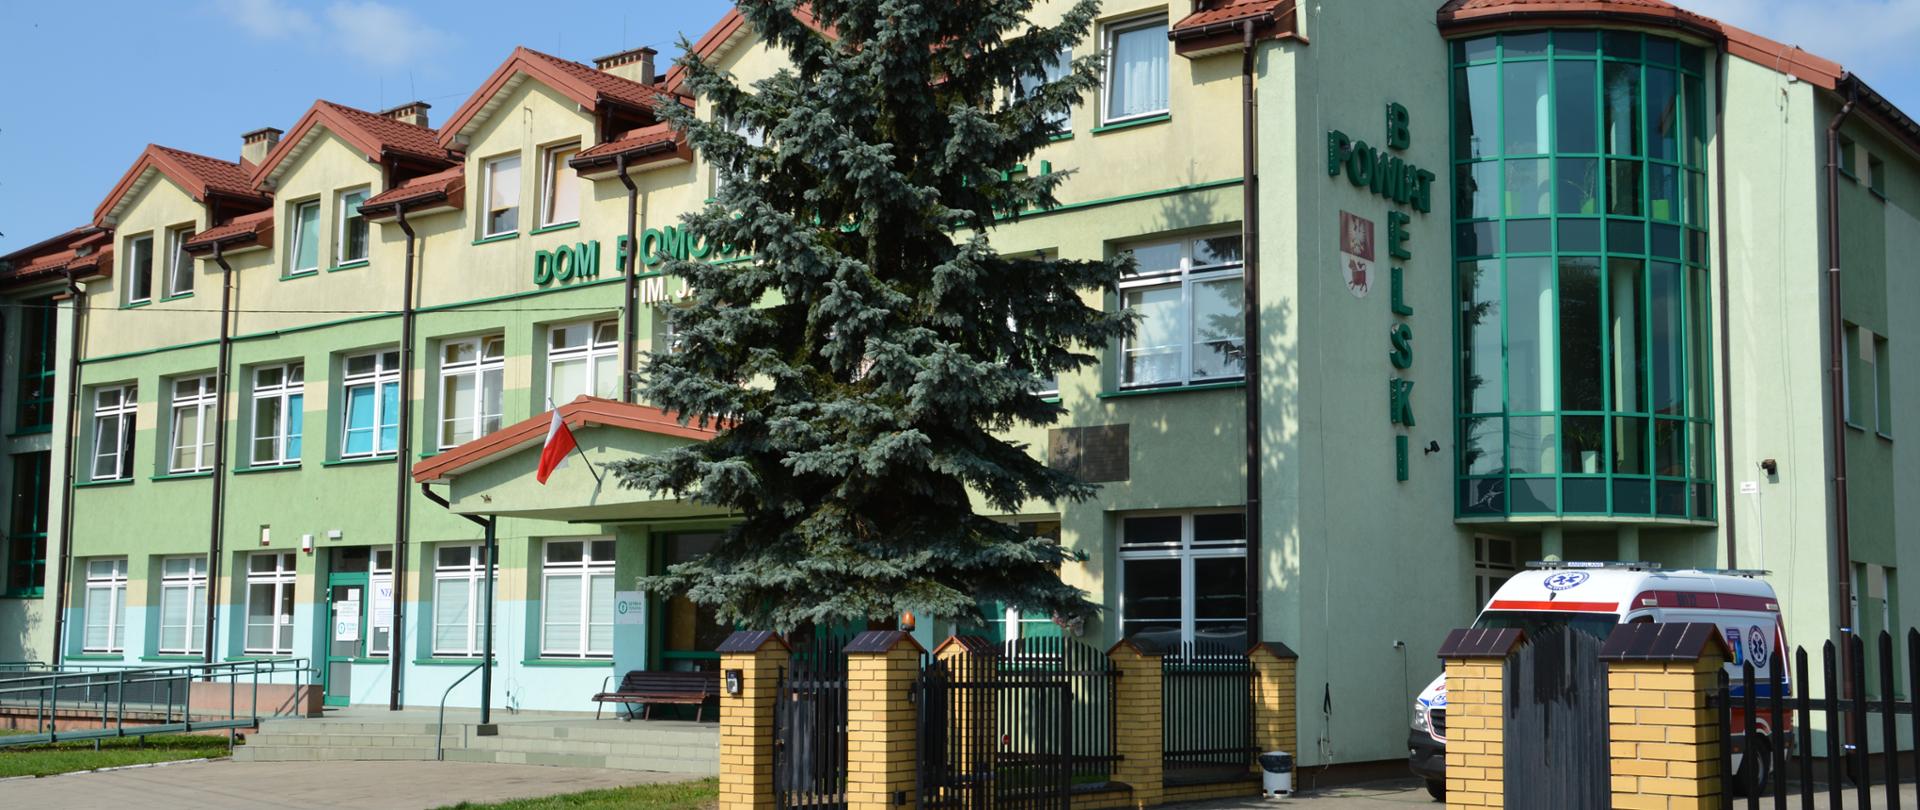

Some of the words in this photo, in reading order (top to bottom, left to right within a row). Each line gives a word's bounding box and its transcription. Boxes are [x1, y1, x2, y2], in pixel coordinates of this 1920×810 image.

[1328, 129, 1436, 214] POWIAT
[533, 239, 600, 286] DOM
[1386, 102, 1416, 482] BIELSKI
